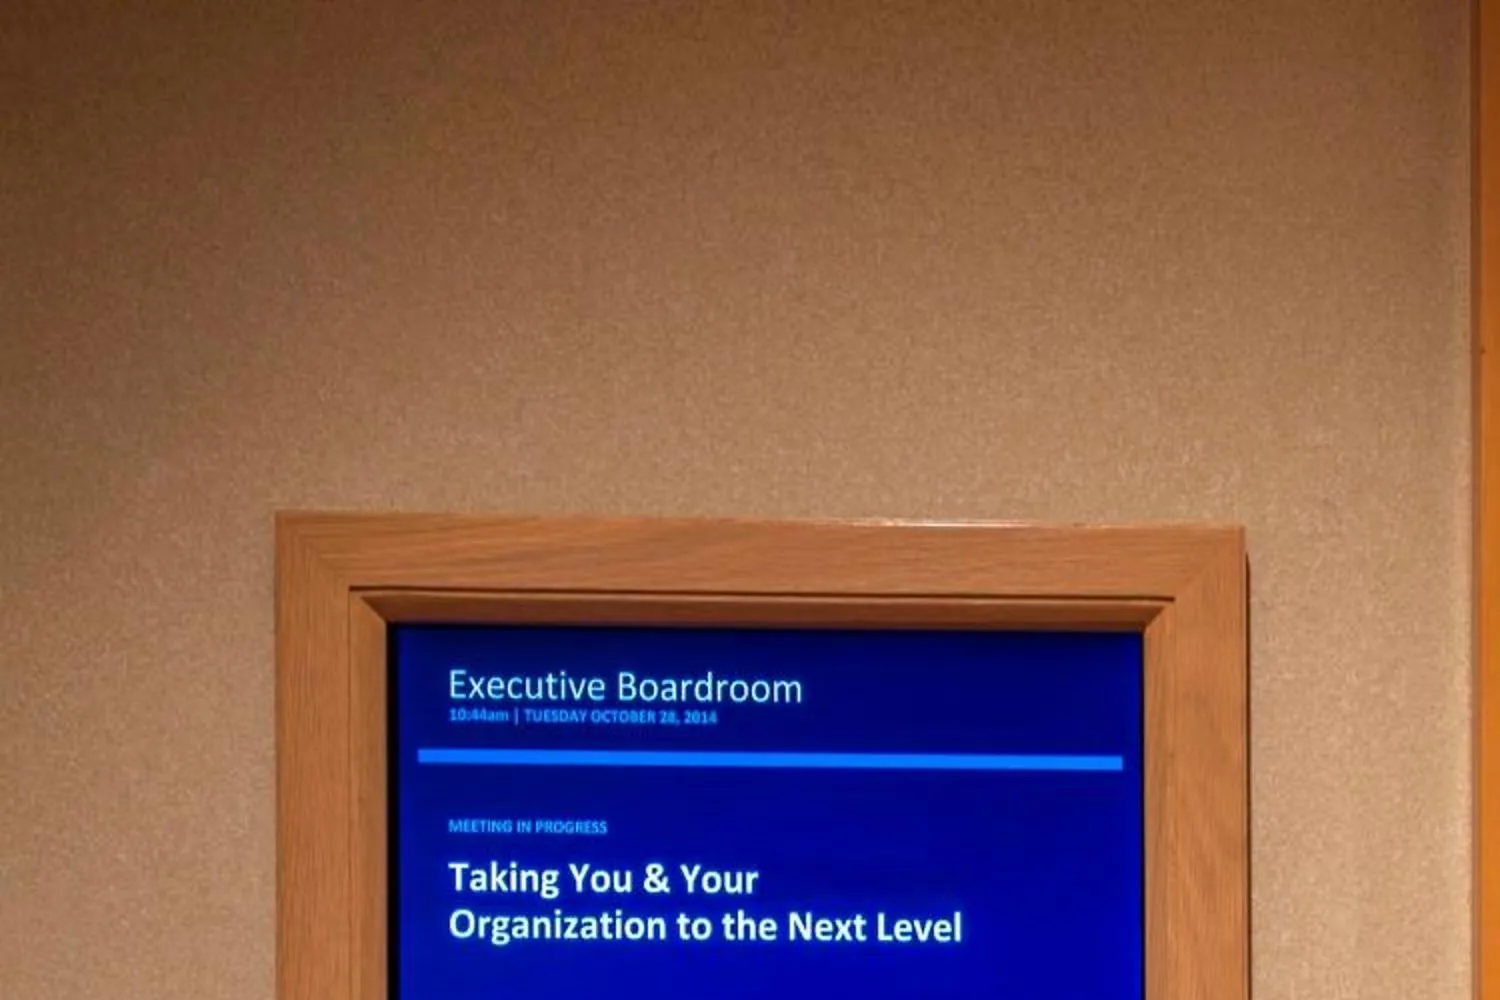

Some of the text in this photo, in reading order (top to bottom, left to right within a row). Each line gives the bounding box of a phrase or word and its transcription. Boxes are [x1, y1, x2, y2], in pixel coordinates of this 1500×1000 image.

[448, 668, 803, 704] Executive Boardroom
[449, 707, 510, 722] 10:44am
[524, 708, 588, 723] TUESDAY
[590, 709, 656, 724] OCTOBER
[658, 710, 681, 725] 28,
[684, 710, 718, 725] 2014
[448, 819, 608, 834] MEETING IN PROGRESS
[447, 860, 759, 899] Taking You & Your
[448, 908, 963, 946] Organization to the Next Level
